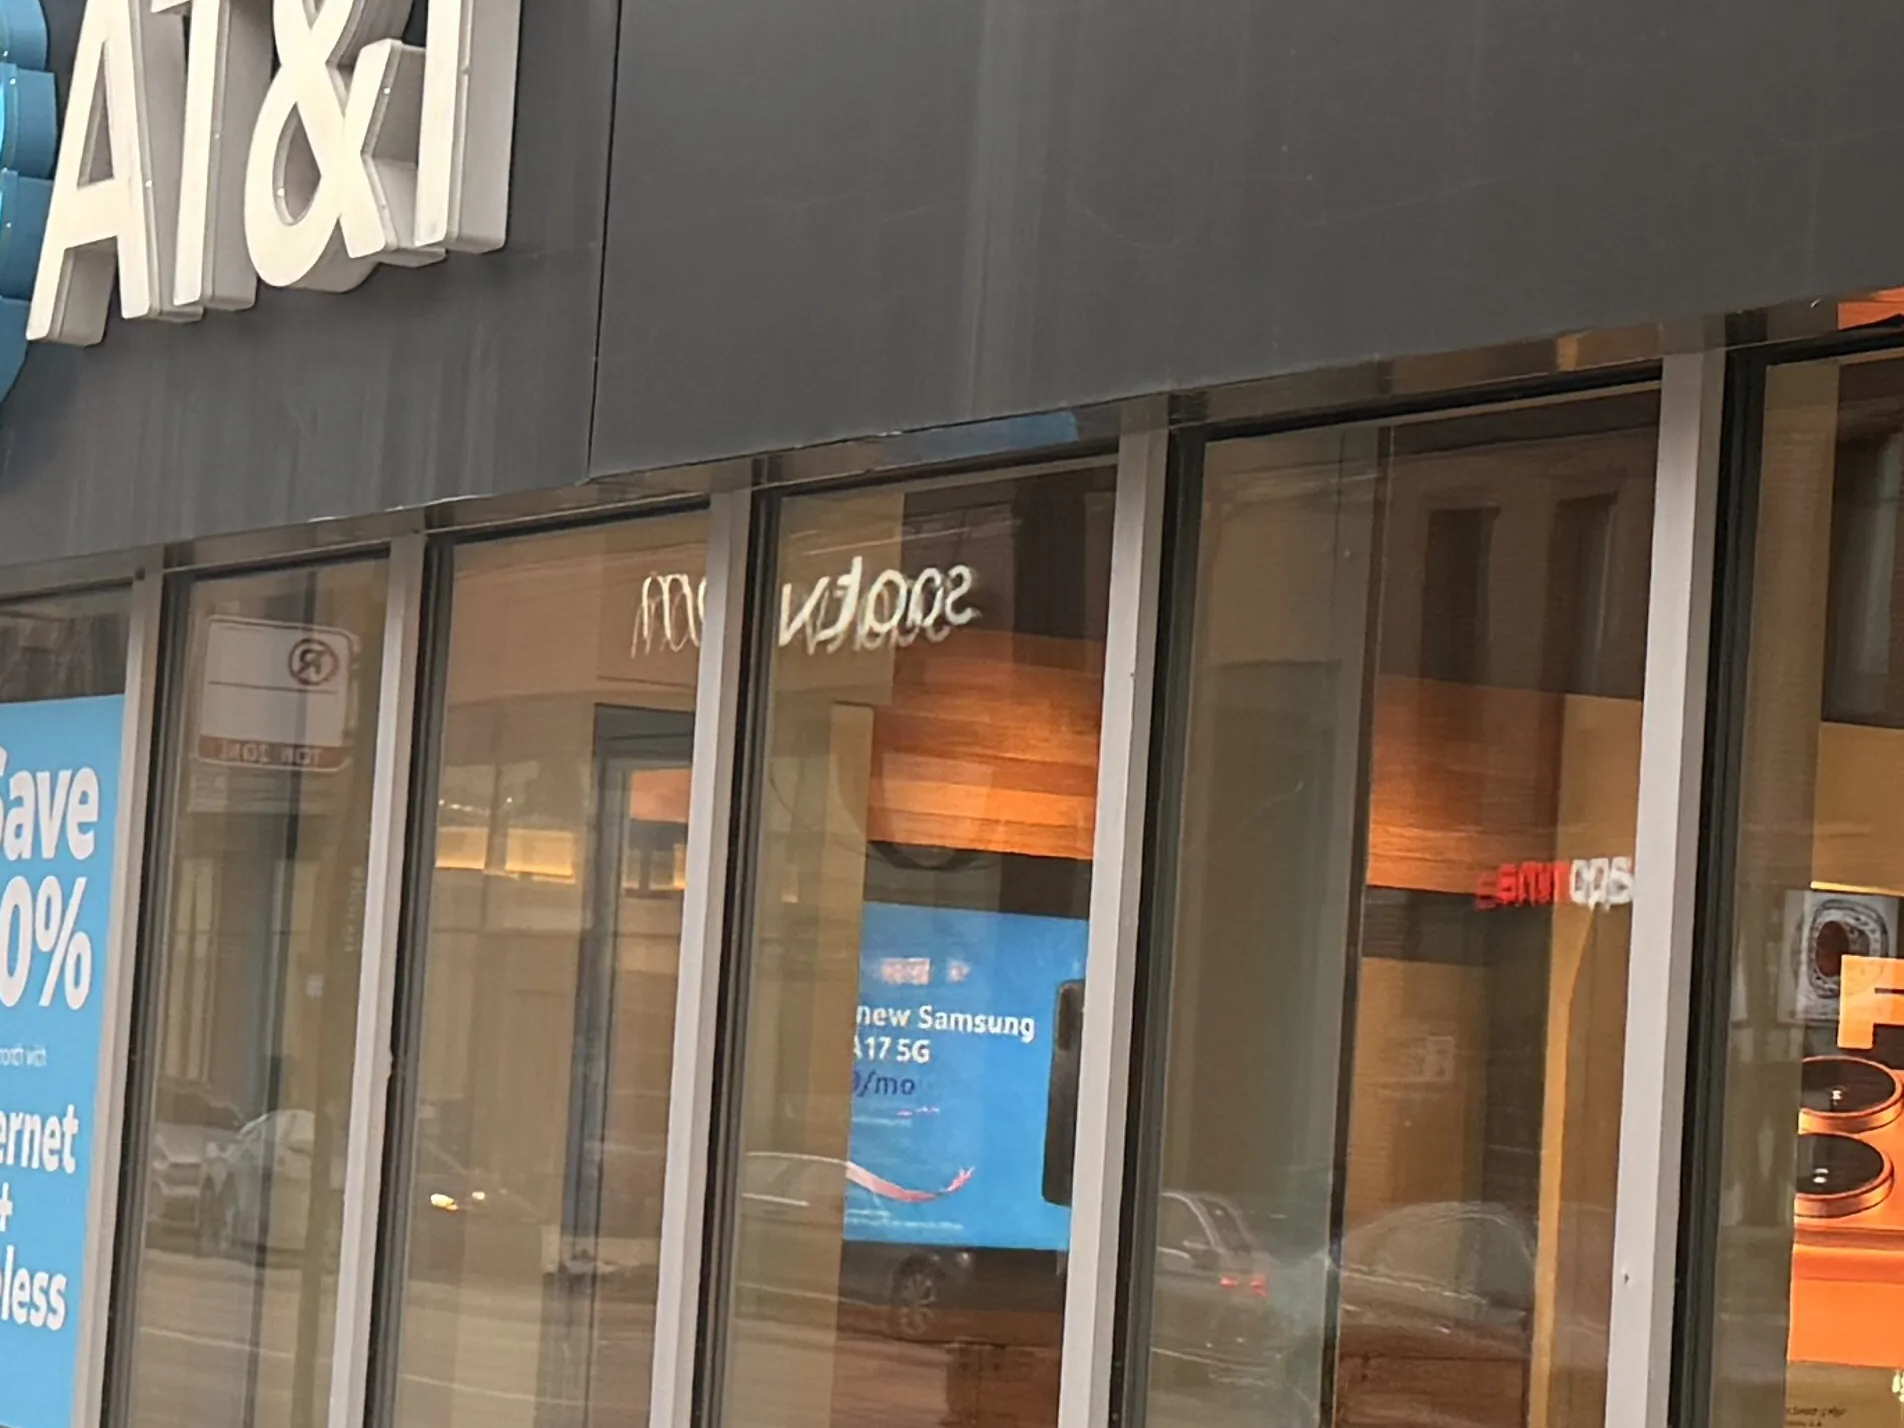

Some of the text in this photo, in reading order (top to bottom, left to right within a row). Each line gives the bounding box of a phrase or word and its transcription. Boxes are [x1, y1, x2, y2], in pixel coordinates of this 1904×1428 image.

[855, 1004, 1036, 1044] new Samsung
[895, 1038, 932, 1064] 5G
